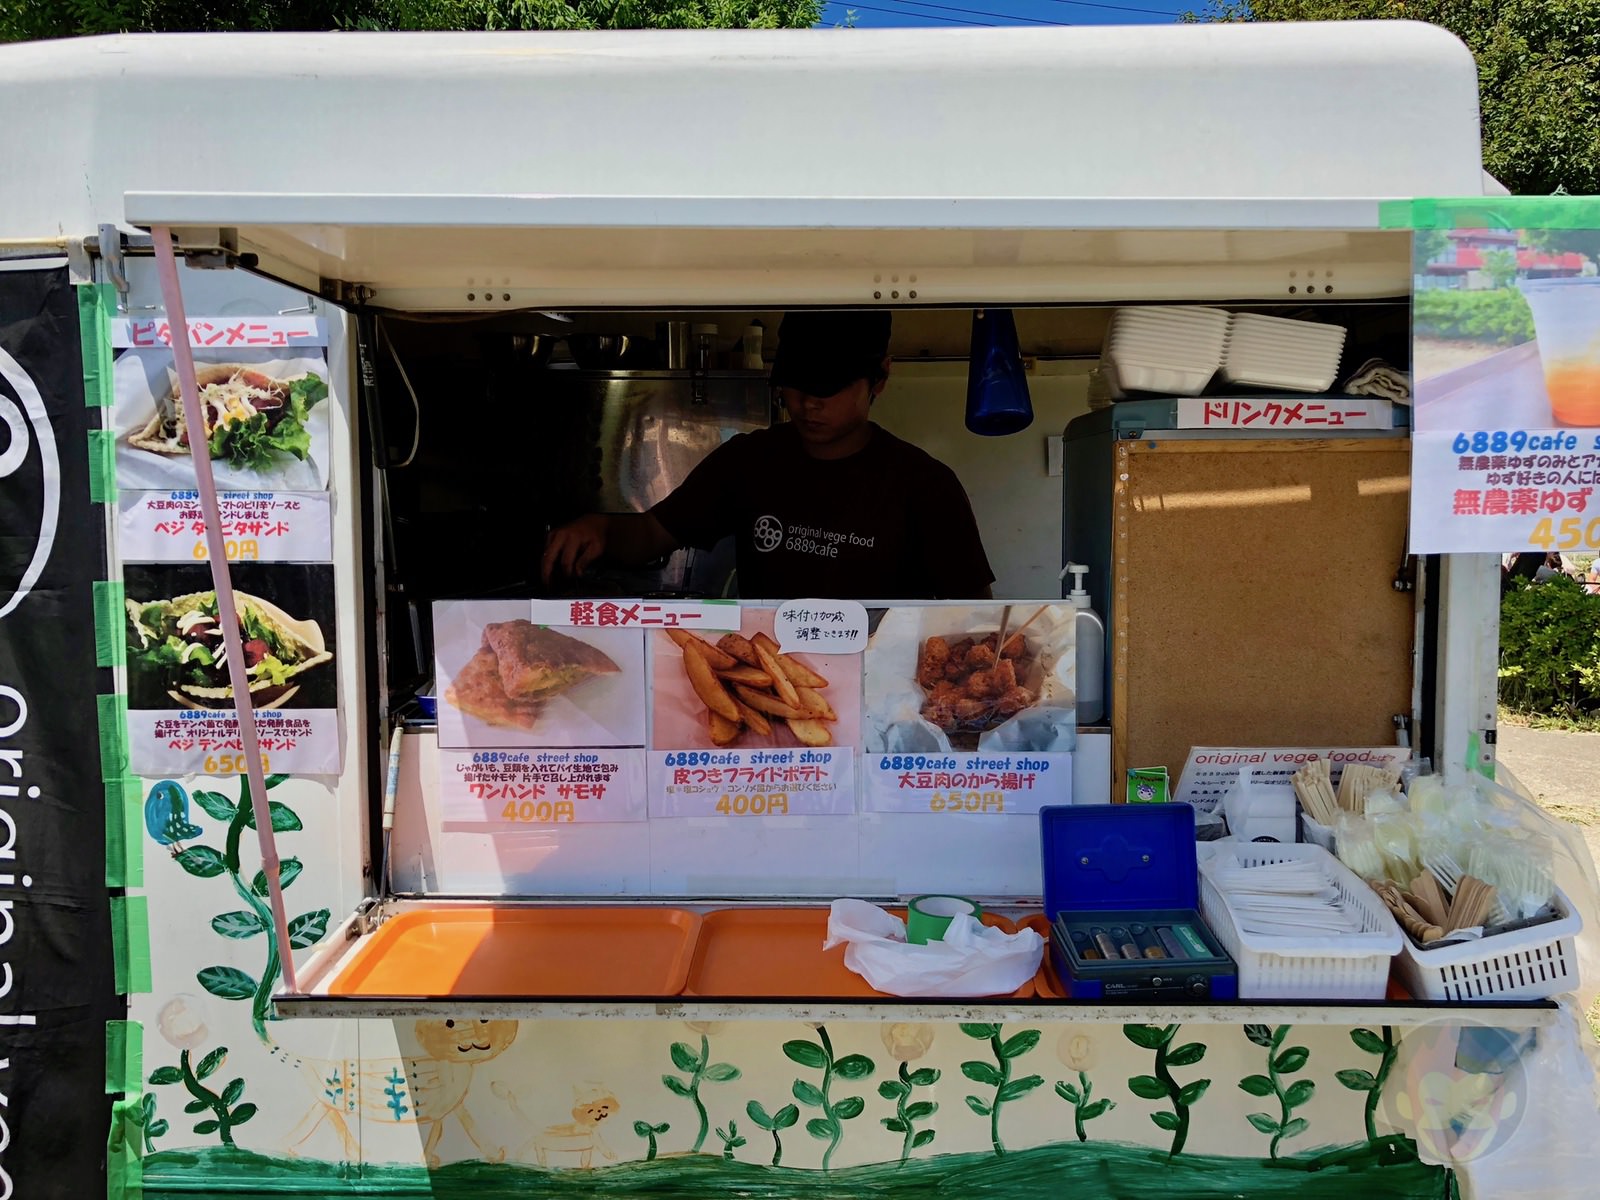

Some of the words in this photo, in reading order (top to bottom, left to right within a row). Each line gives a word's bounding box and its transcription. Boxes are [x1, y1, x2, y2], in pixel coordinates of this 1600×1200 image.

[1204, 402, 1367, 426] ドリンクメニュー
[1452, 430, 1577, 454] 6889cafe
[1458, 454, 1600, 471] 無農薬ゆずのみとア
[223, 492, 249, 500] street
[253, 492, 274, 501] shop
[1453, 487, 1594, 515] 無農薬ゆず
[154, 521, 184, 536] ベジ
[191, 521, 289, 536] タピタサンド
[788, 524, 822, 538] original
[823, 531, 847, 544] vege
[848, 532, 875, 548] food
[192, 539, 259, 560] 60円
[785, 537, 838, 558] 6889cafe
[570, 601, 702, 627] 軽食メニュー
[179, 710, 226, 719] 6889cafe
[262, 710, 282, 719] shop
[169, 740, 194, 751] ベジ
[472, 752, 530, 763] 6889cafe
[536, 752, 570, 763] street
[573, 752, 599, 763] shop
[664, 752, 741, 766] 6889cafe
[750, 751, 795, 764] street
[799, 750, 832, 764] shop
[880, 755, 956, 770] 6889cafe
[966, 756, 1012, 770] street
[1016, 757, 1050, 772] shop
[1195, 752, 1267, 765] original
[1273, 752, 1319, 764] vege
[673, 765, 829, 784] 皮つきフライドポテト
[897, 771, 1036, 790] 大豆肉のから揚げ
[469, 783, 545, 800] ワンハンド
[557, 783, 606, 800] サモサ
[929, 790, 1004, 812] 650円
[501, 800, 575, 822] 400円
[715, 792, 789, 815] 400円
